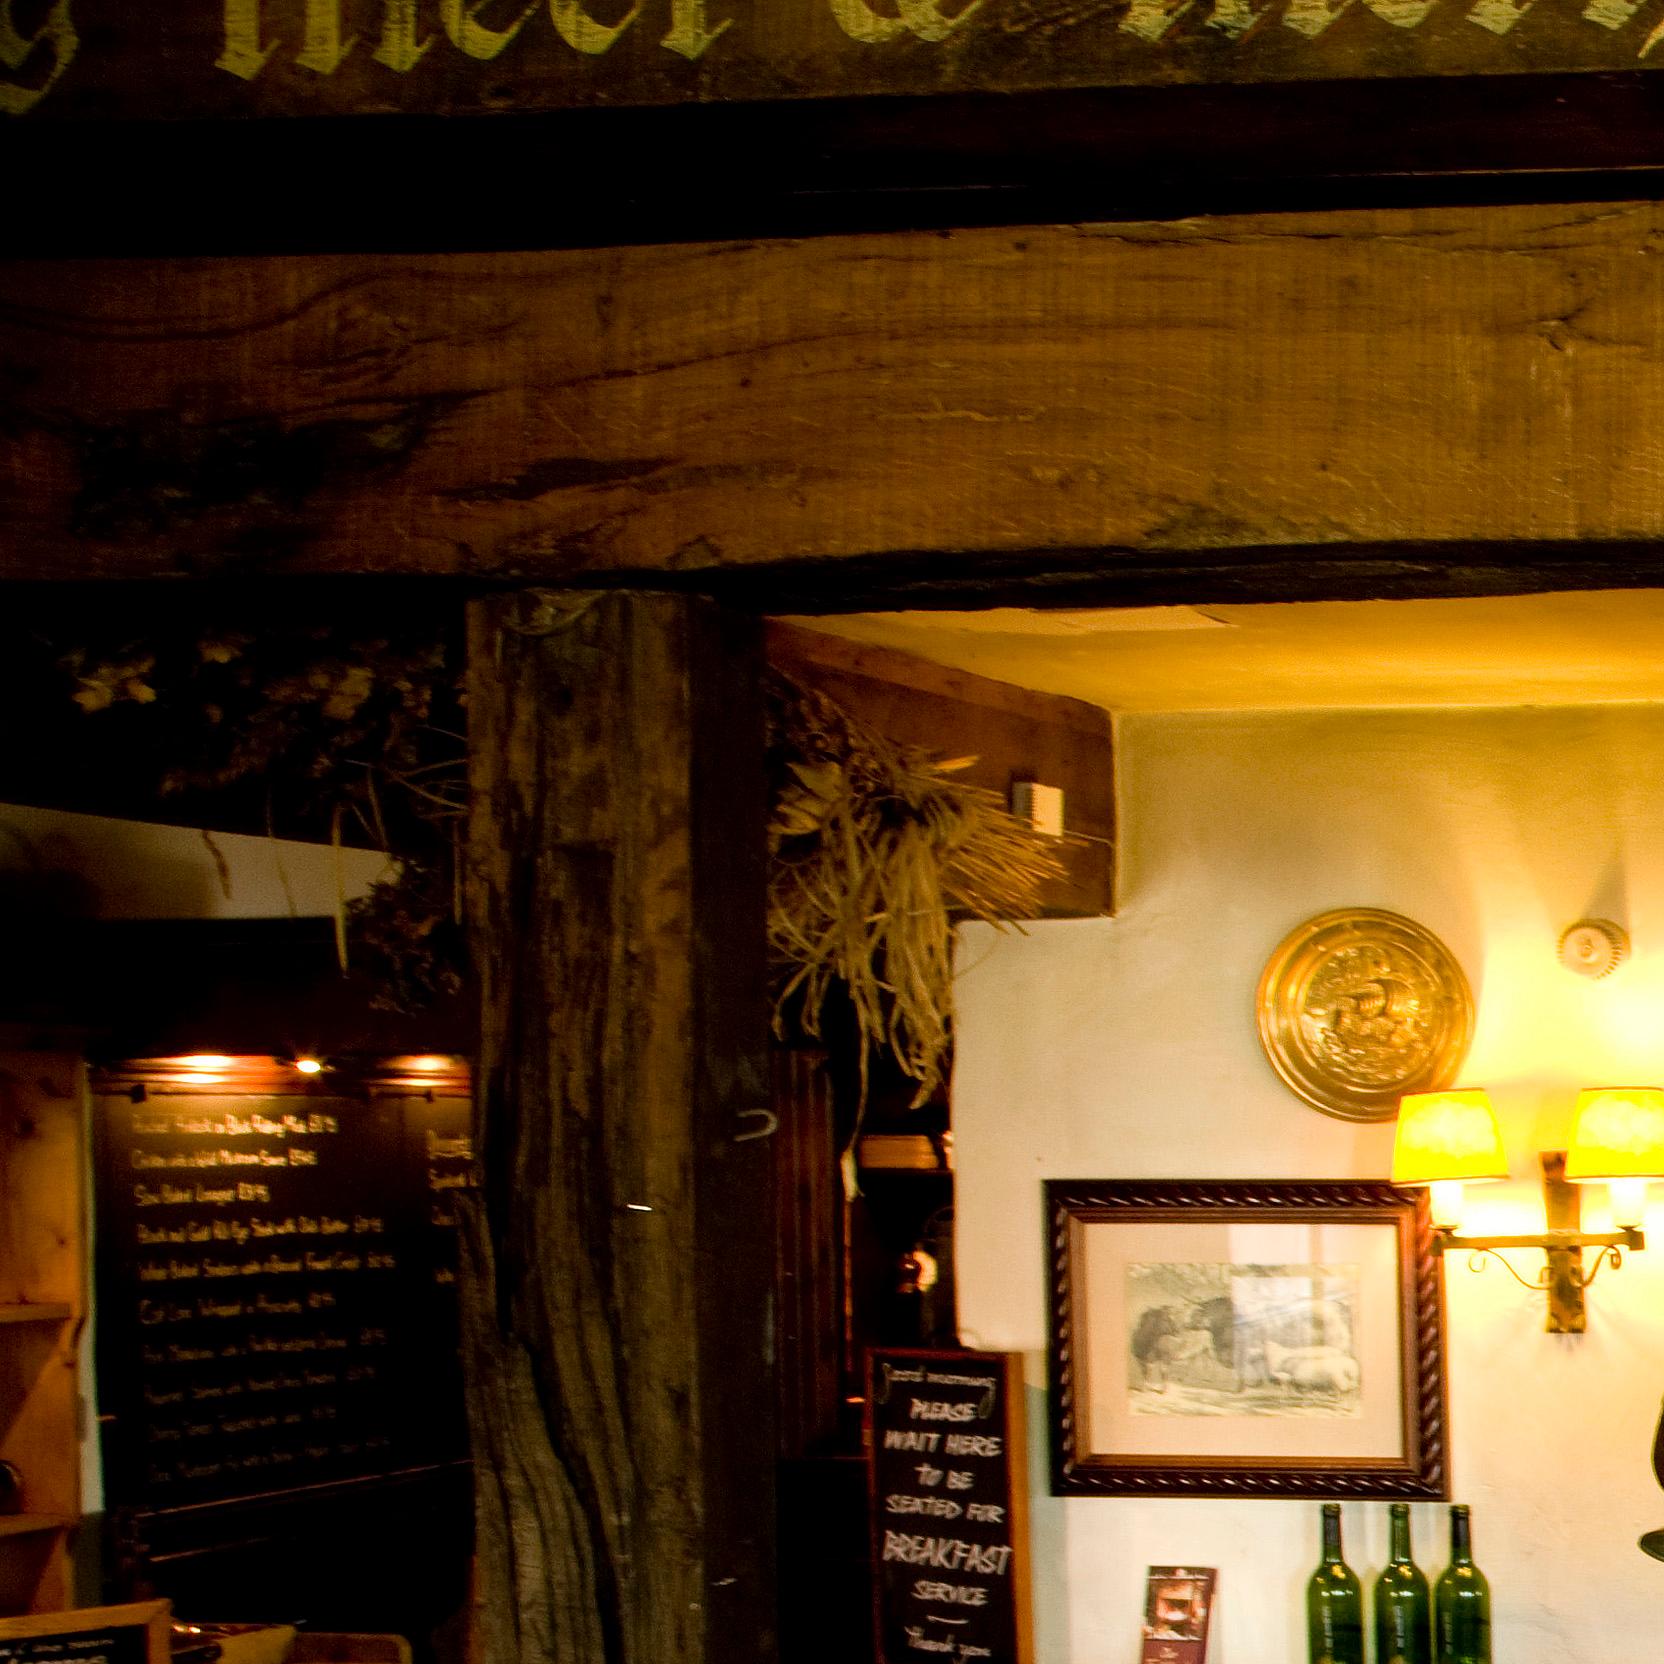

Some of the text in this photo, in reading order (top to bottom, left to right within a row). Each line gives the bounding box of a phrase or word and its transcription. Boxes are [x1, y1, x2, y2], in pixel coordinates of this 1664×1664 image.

[909, 1398, 979, 1422] PLEASE
[884, 1429, 1003, 1458] WAIT HERE
[946, 1469, 976, 1491] BE
[965, 1502, 1006, 1524] FOR
[882, 1529, 1013, 1577] BREAKFAST
[911, 1579, 989, 1607] SERVICE
